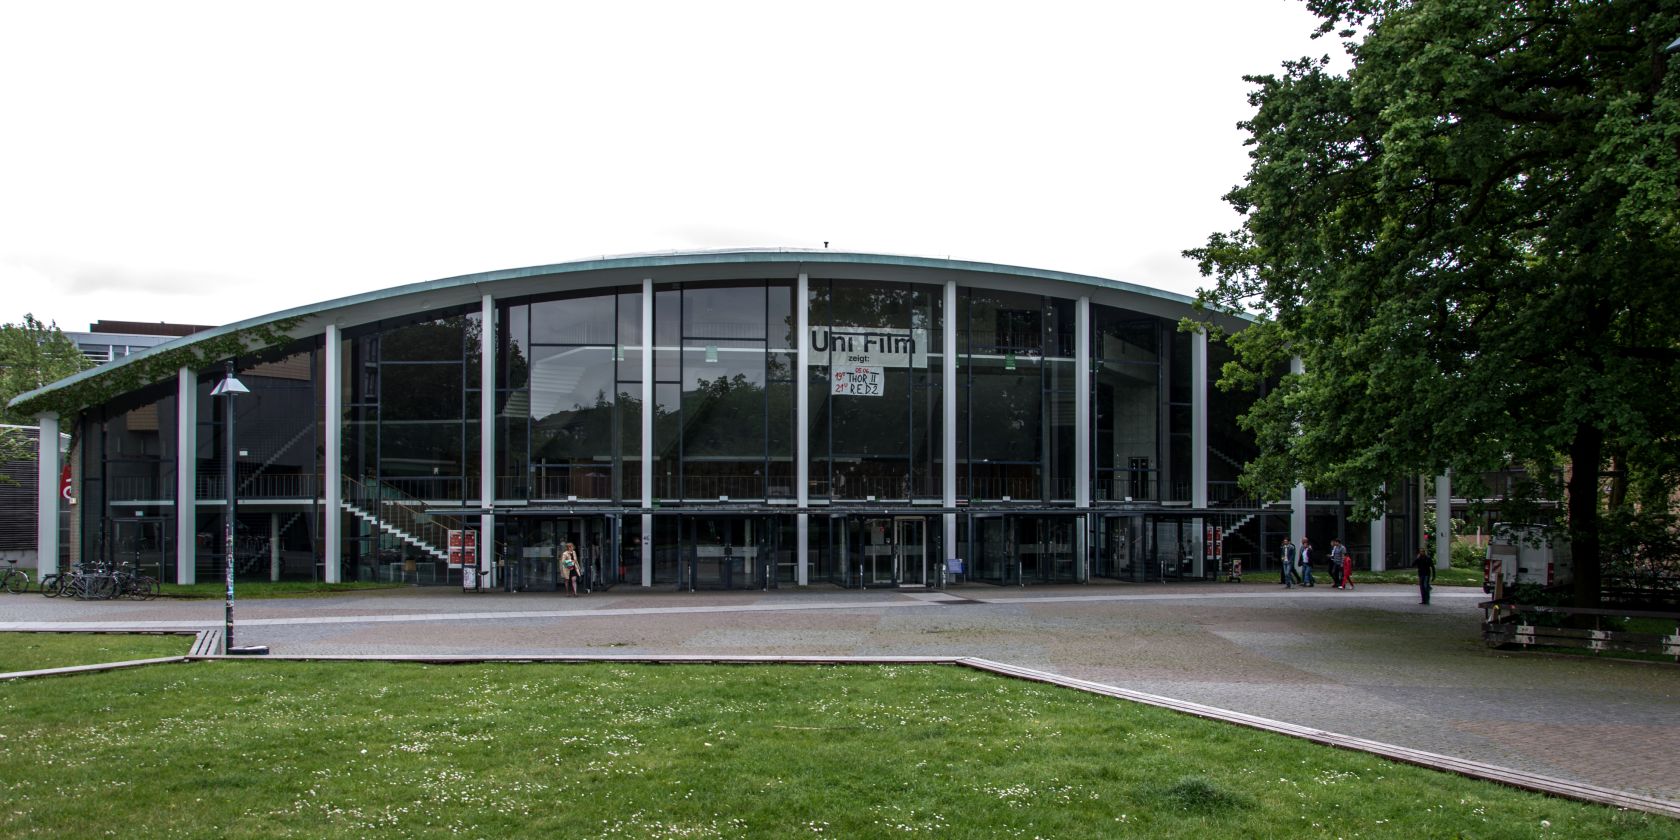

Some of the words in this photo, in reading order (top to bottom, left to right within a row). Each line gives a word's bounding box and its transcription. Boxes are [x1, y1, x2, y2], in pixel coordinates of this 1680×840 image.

[812, 330, 853, 352] Uni
[864, 332, 915, 354] Film
[848, 354, 870, 363] zeigt:
[847, 372, 867, 384] THOR
